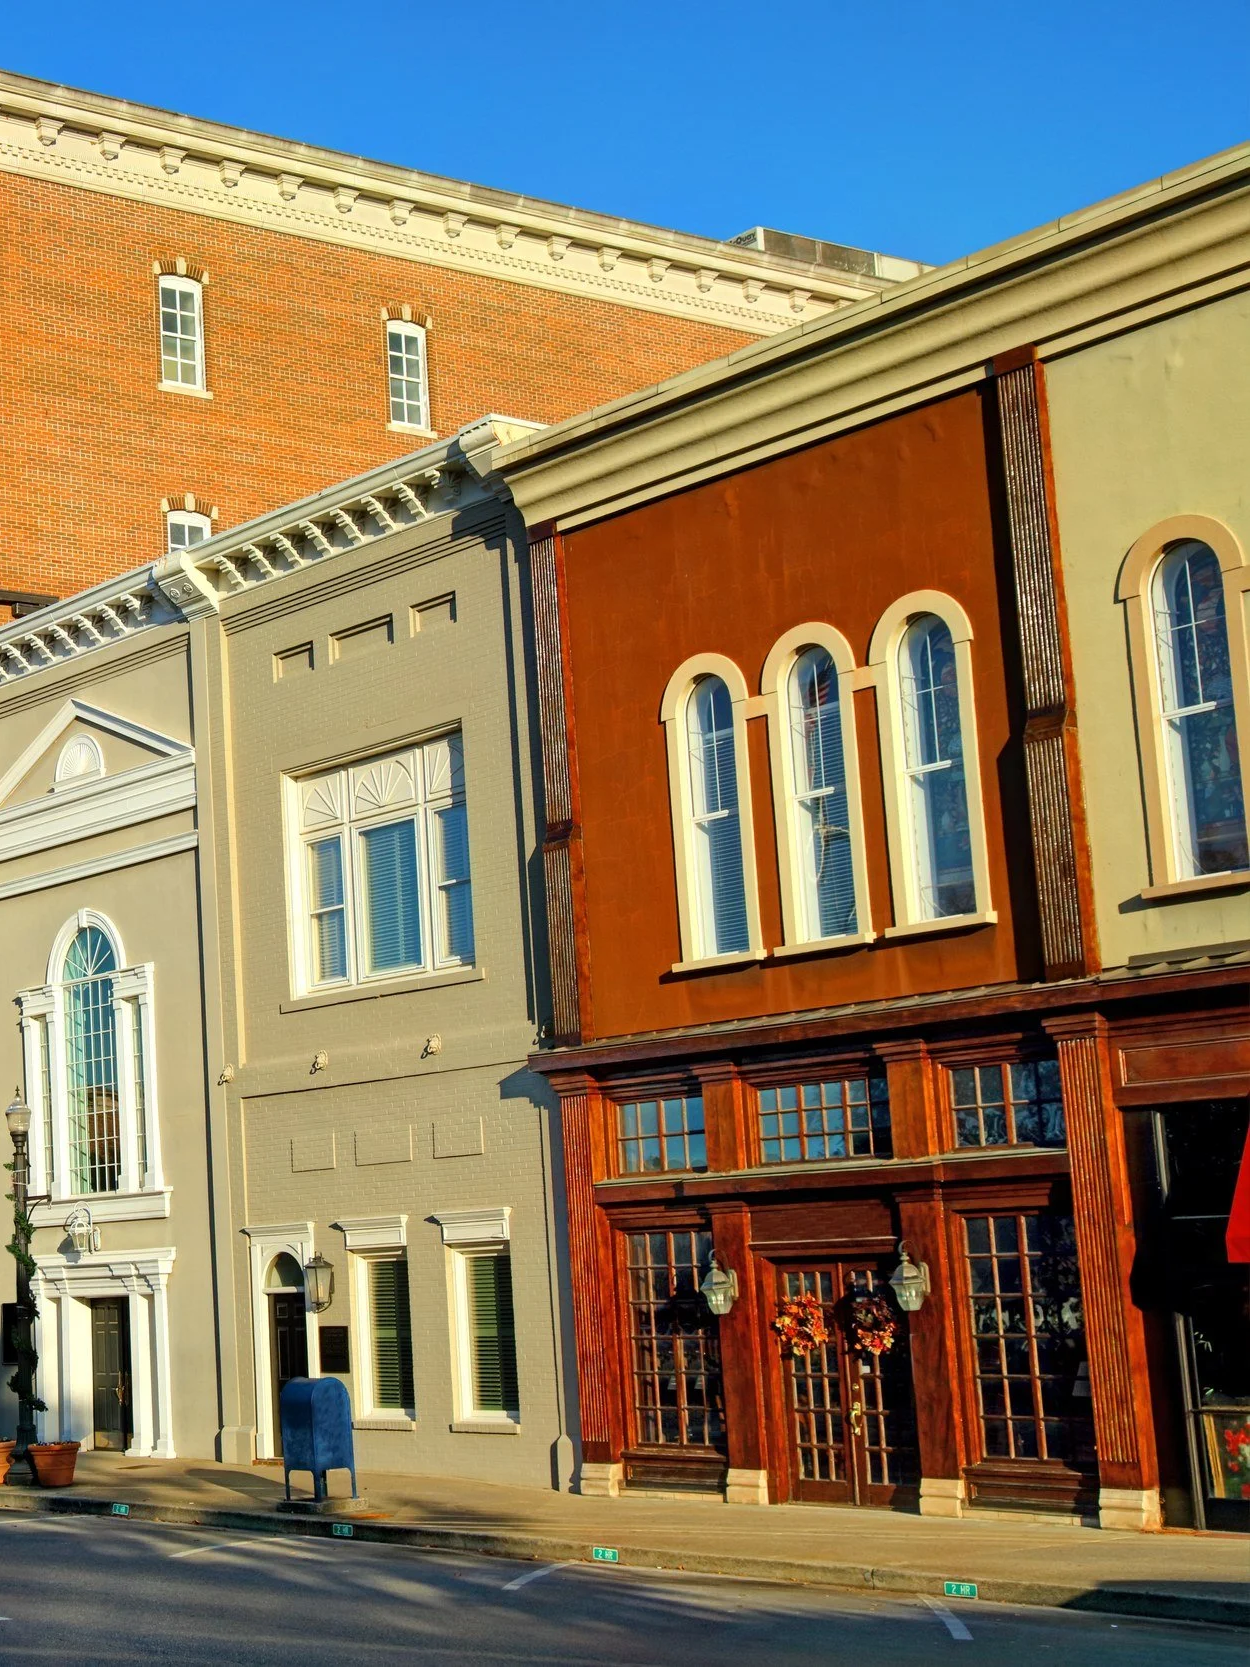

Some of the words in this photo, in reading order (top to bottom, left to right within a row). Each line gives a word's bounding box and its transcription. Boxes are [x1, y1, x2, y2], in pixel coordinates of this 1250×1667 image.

[598, 1549, 603, 1559] 2
[605, 1551, 613, 1560] HR
[951, 1584, 956, 1594] 2
[960, 1585, 971, 1595] HR
